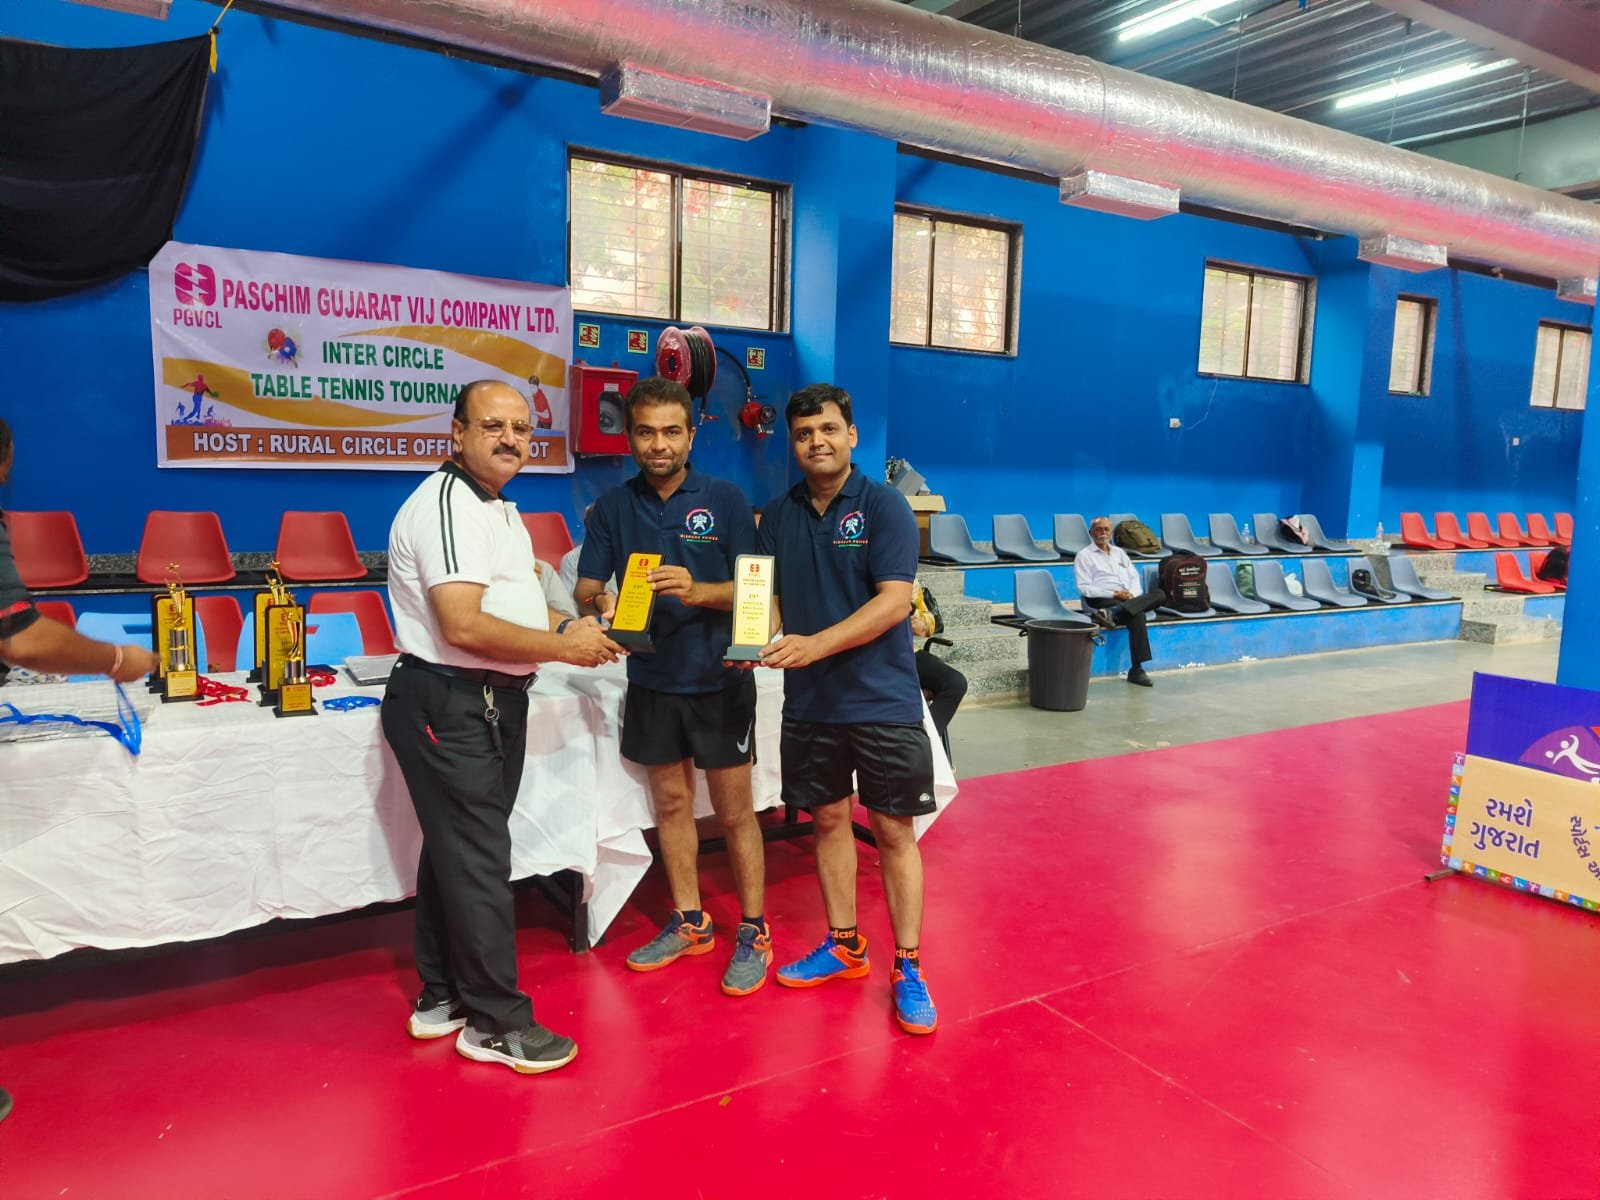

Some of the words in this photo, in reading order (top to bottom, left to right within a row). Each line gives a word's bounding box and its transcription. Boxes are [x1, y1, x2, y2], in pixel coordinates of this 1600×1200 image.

[173, 308, 222, 329] PGVCL
[222, 279, 311, 315] PASCHIM
[317, 287, 402, 322] GUJARAT
[407, 295, 435, 325] VIJ
[441, 298, 521, 331] COMPANY
[527, 306, 559, 334] LTD.
[322, 341, 377, 366] INTER
[383, 345, 444, 370] CIRCLE
[251, 373, 312, 398] TABLE
[318, 376, 385, 401] TENNIS
[193, 432, 252, 453] HOST
[270, 434, 336, 454] RURAL
[341, 436, 408, 456] CIRCLE
[413, 438, 454, 457] OFFI
[1485, 798, 1533, 828] રમશે
[1470, 821, 1541, 859] ગુજરાત
